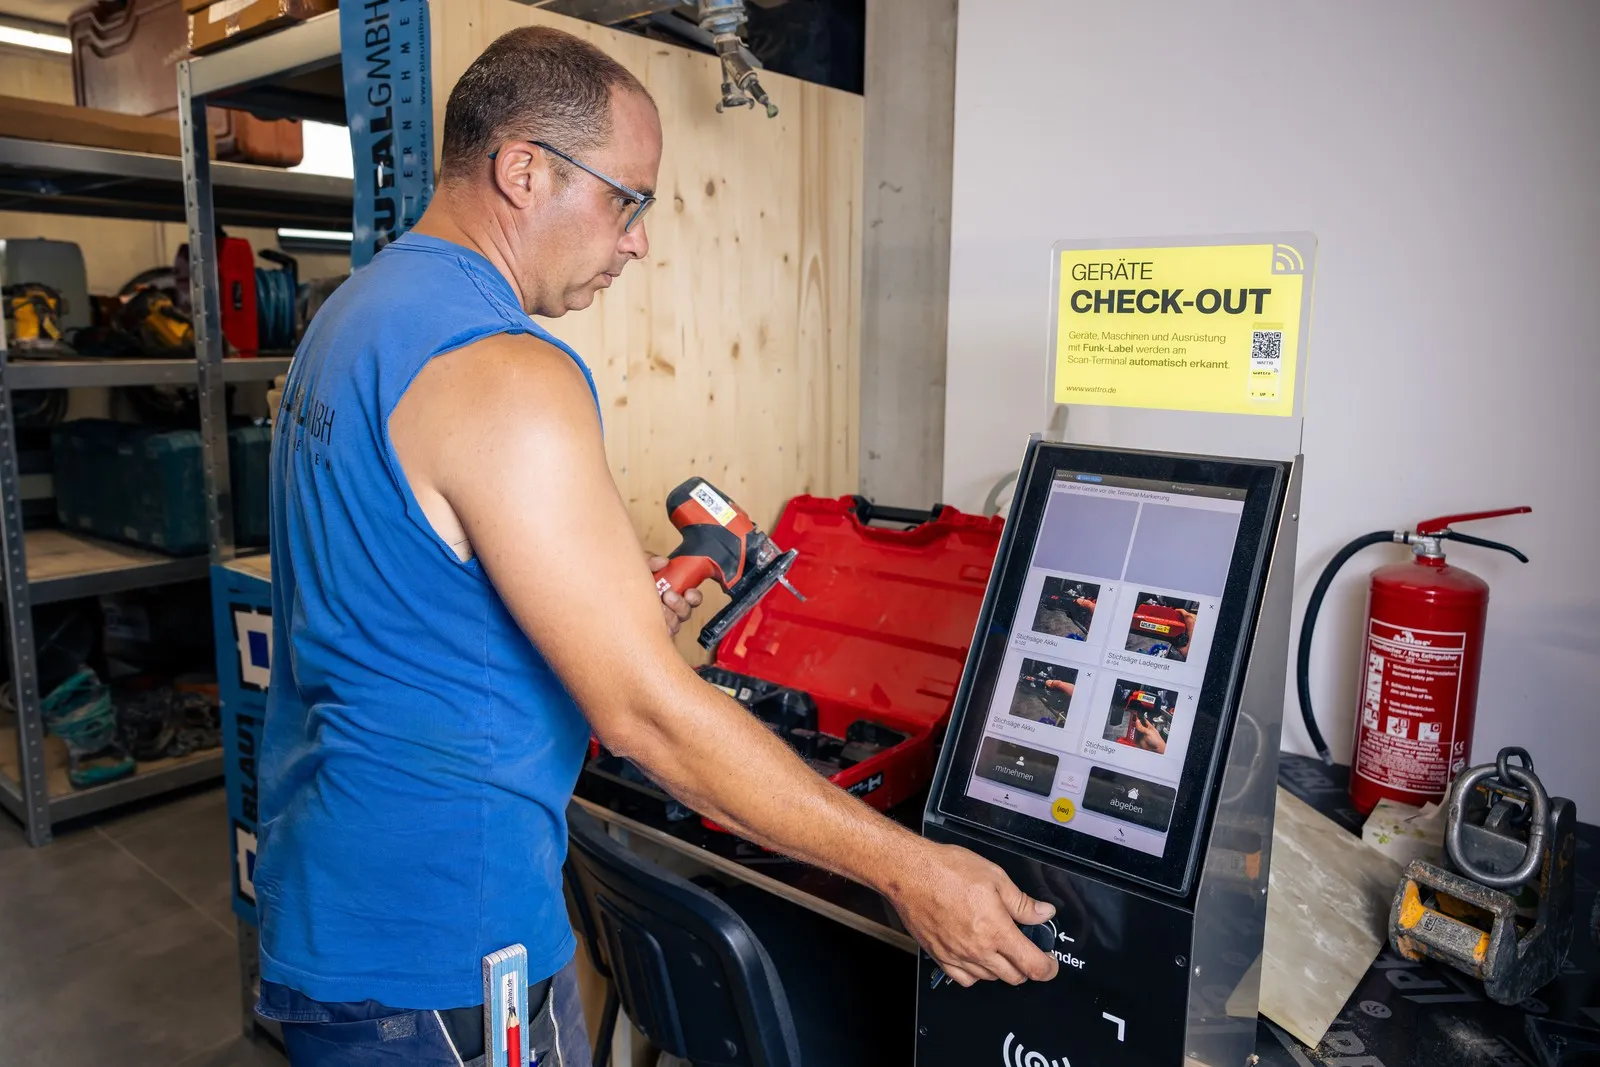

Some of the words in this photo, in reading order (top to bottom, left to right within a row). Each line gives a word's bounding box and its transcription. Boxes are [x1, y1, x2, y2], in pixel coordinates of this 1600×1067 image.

[1071, 258, 1153, 281] GERÄTE
[1070, 288, 1272, 315] CHECK-OUT
[1068, 330, 1099, 341] Geräte,
[1101, 331, 1150, 341] Maschinen
[1151, 333, 1169, 341] und
[1171, 332, 1227, 345] Ausrüstung
[1068, 343, 1081, 352] mit
[1082, 343, 1134, 353] Funk-Label
[1136, 345, 1170, 354] werden
[1172, 347, 1187, 355] am
[1067, 354, 1127, 365] Scan-Terminal
[1128, 357, 1187, 368] automatisch
[1189, 360, 1230, 370] erkannt.
[1066, 385, 1117, 394] www.wattro.de
[1117, 489, 1170, 502] Terminal-Markierung
[1016, 632, 1044, 644] Stichsäge
[1043, 638, 1058, 648] Akku
[1108, 652, 1138, 664] Stichsäge
[1138, 657, 1170, 671] Ladegerät
[1421, 652, 1458, 662] Extinguisher
[993, 716, 1021, 729] Stichsäge
[1021, 723, 1036, 733] Akku
[1085, 740, 1116, 754] Stichsäge
[995, 764, 1034, 782] mitnehmen
[1109, 797, 1144, 815] abgeben
